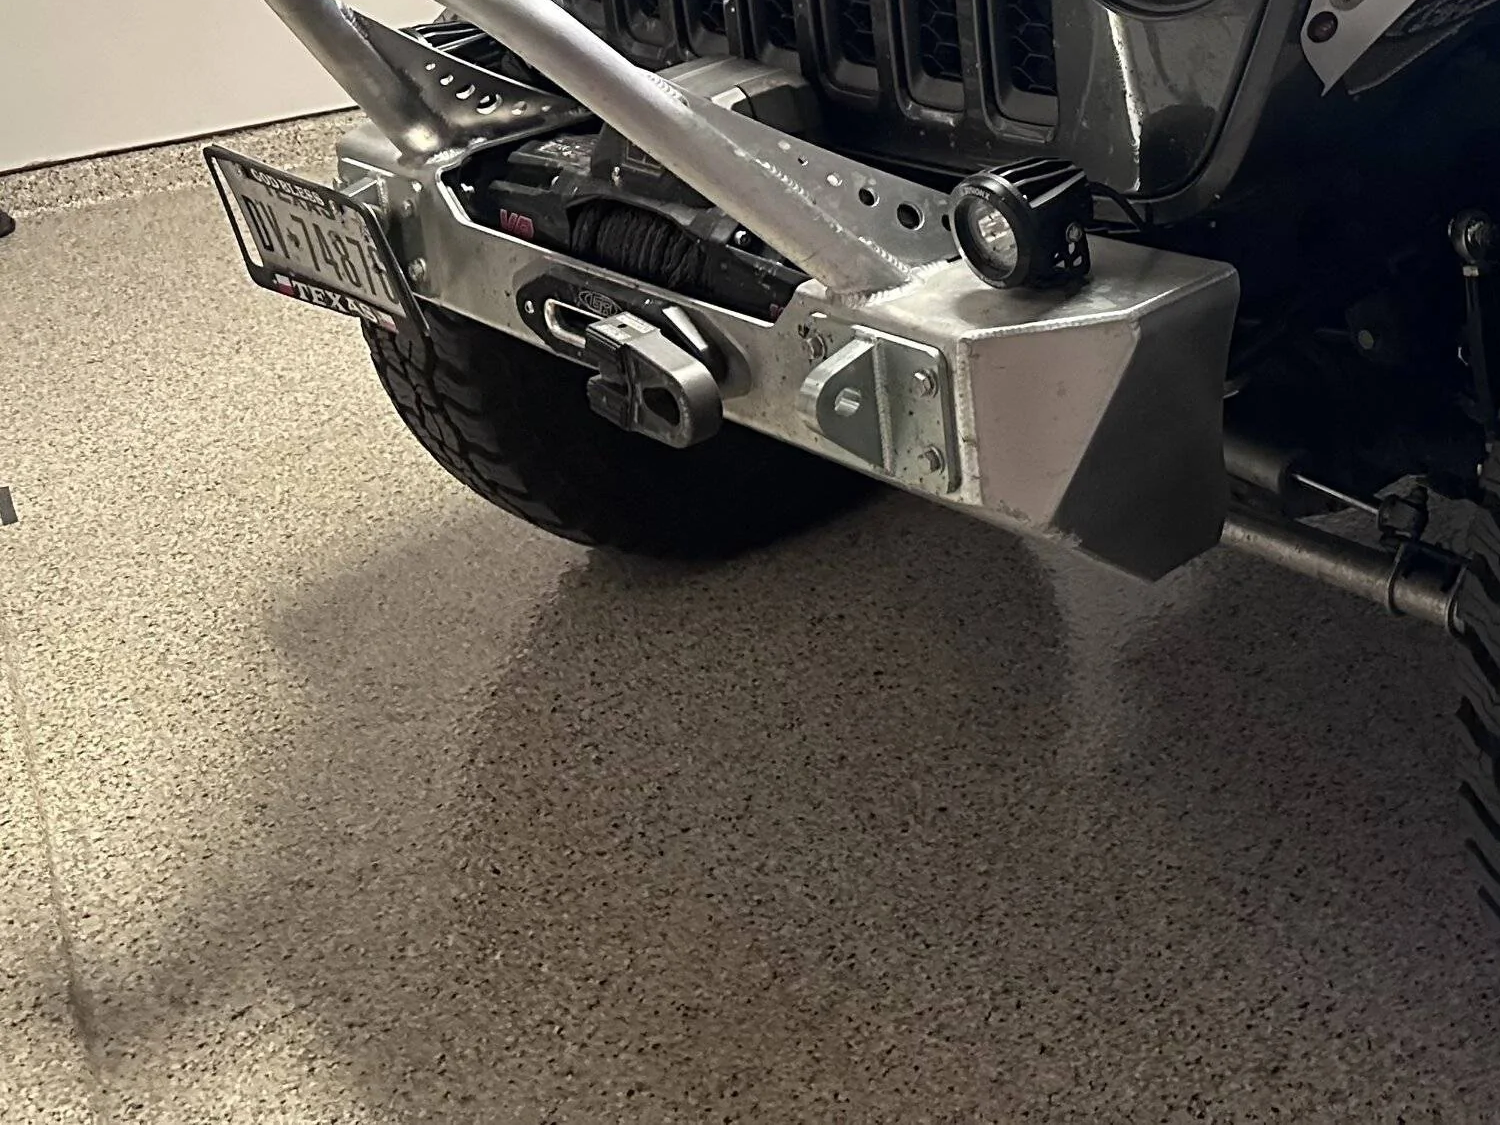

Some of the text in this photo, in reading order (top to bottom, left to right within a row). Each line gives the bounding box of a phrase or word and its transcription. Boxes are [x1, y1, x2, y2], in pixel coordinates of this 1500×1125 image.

[250, 168, 325, 207] GOD BLESS
[241, 194, 290, 260] DV
[291, 278, 378, 324] TEXAS
